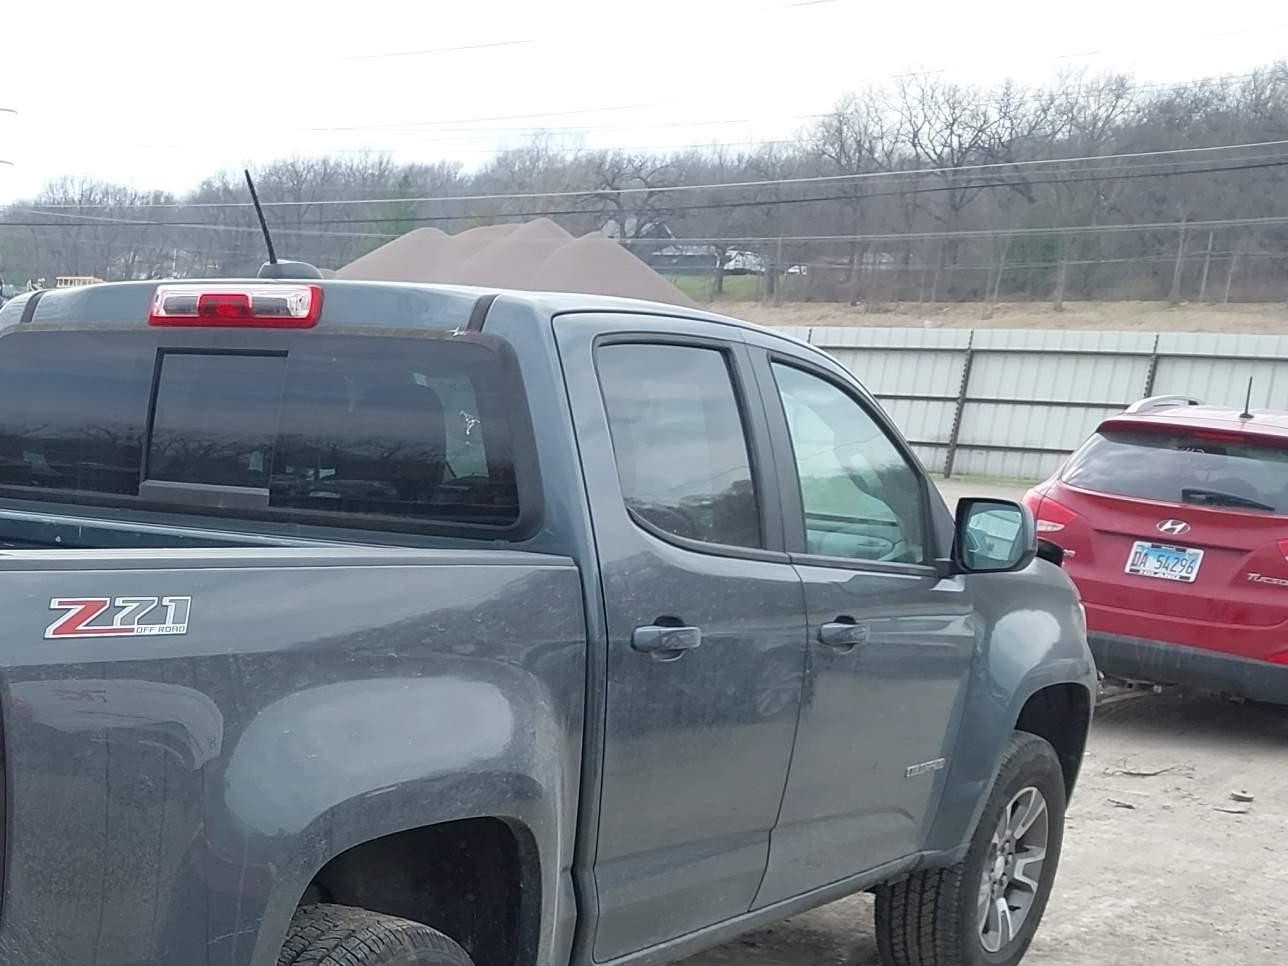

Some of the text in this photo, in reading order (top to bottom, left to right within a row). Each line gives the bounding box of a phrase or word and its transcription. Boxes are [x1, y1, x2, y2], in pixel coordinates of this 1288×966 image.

[1154, 555, 1195, 575] 54296
[44, 596, 192, 639] Z71
[136, 624, 185, 635] OFF ROAD
